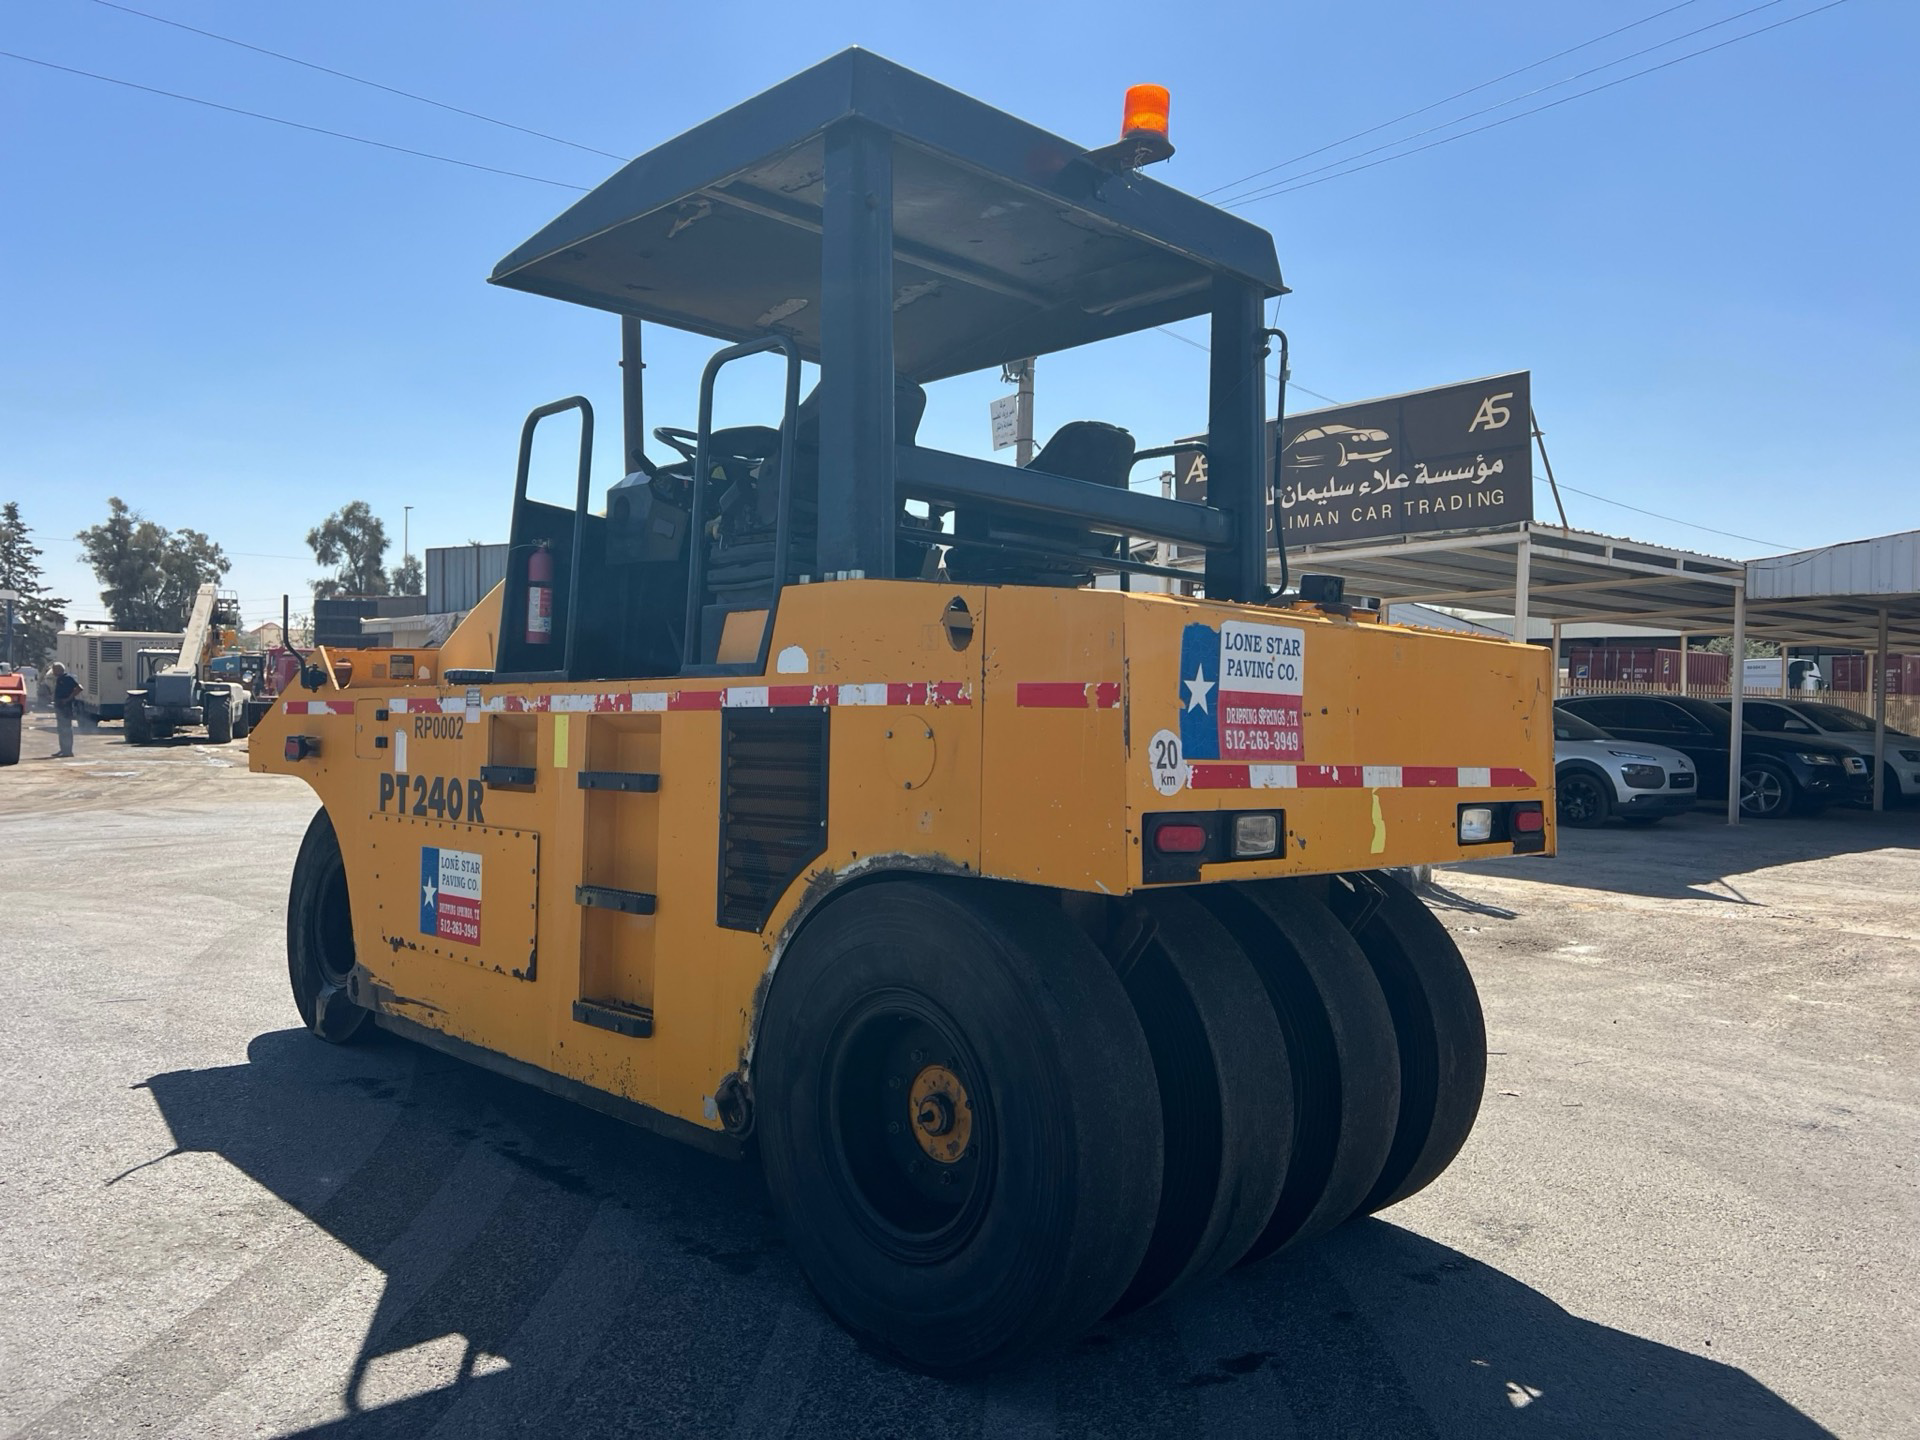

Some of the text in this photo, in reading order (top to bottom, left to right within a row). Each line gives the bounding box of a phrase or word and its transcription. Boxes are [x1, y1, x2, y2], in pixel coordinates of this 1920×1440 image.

[1414, 454, 1504, 485] مؤسسة
[1281, 476, 1354, 509] سليمان
[1359, 469, 1410, 497] علاء
[1351, 504, 1392, 522] CAR
[1404, 489, 1505, 516] TRADING
[1225, 632, 1301, 657] LONE STAR
[1227, 658, 1298, 682] PAVING CO.
[414, 716, 463, 740] RP0002
[1226, 707, 1257, 725] DRIPPING
[1226, 729, 1299, 751] 512-263-3949
[1155, 739, 1178, 770] 20
[1161, 773, 1176, 786] km
[441, 856, 480, 875] LONE STAR
[442, 873, 479, 891] PAVING CO.
